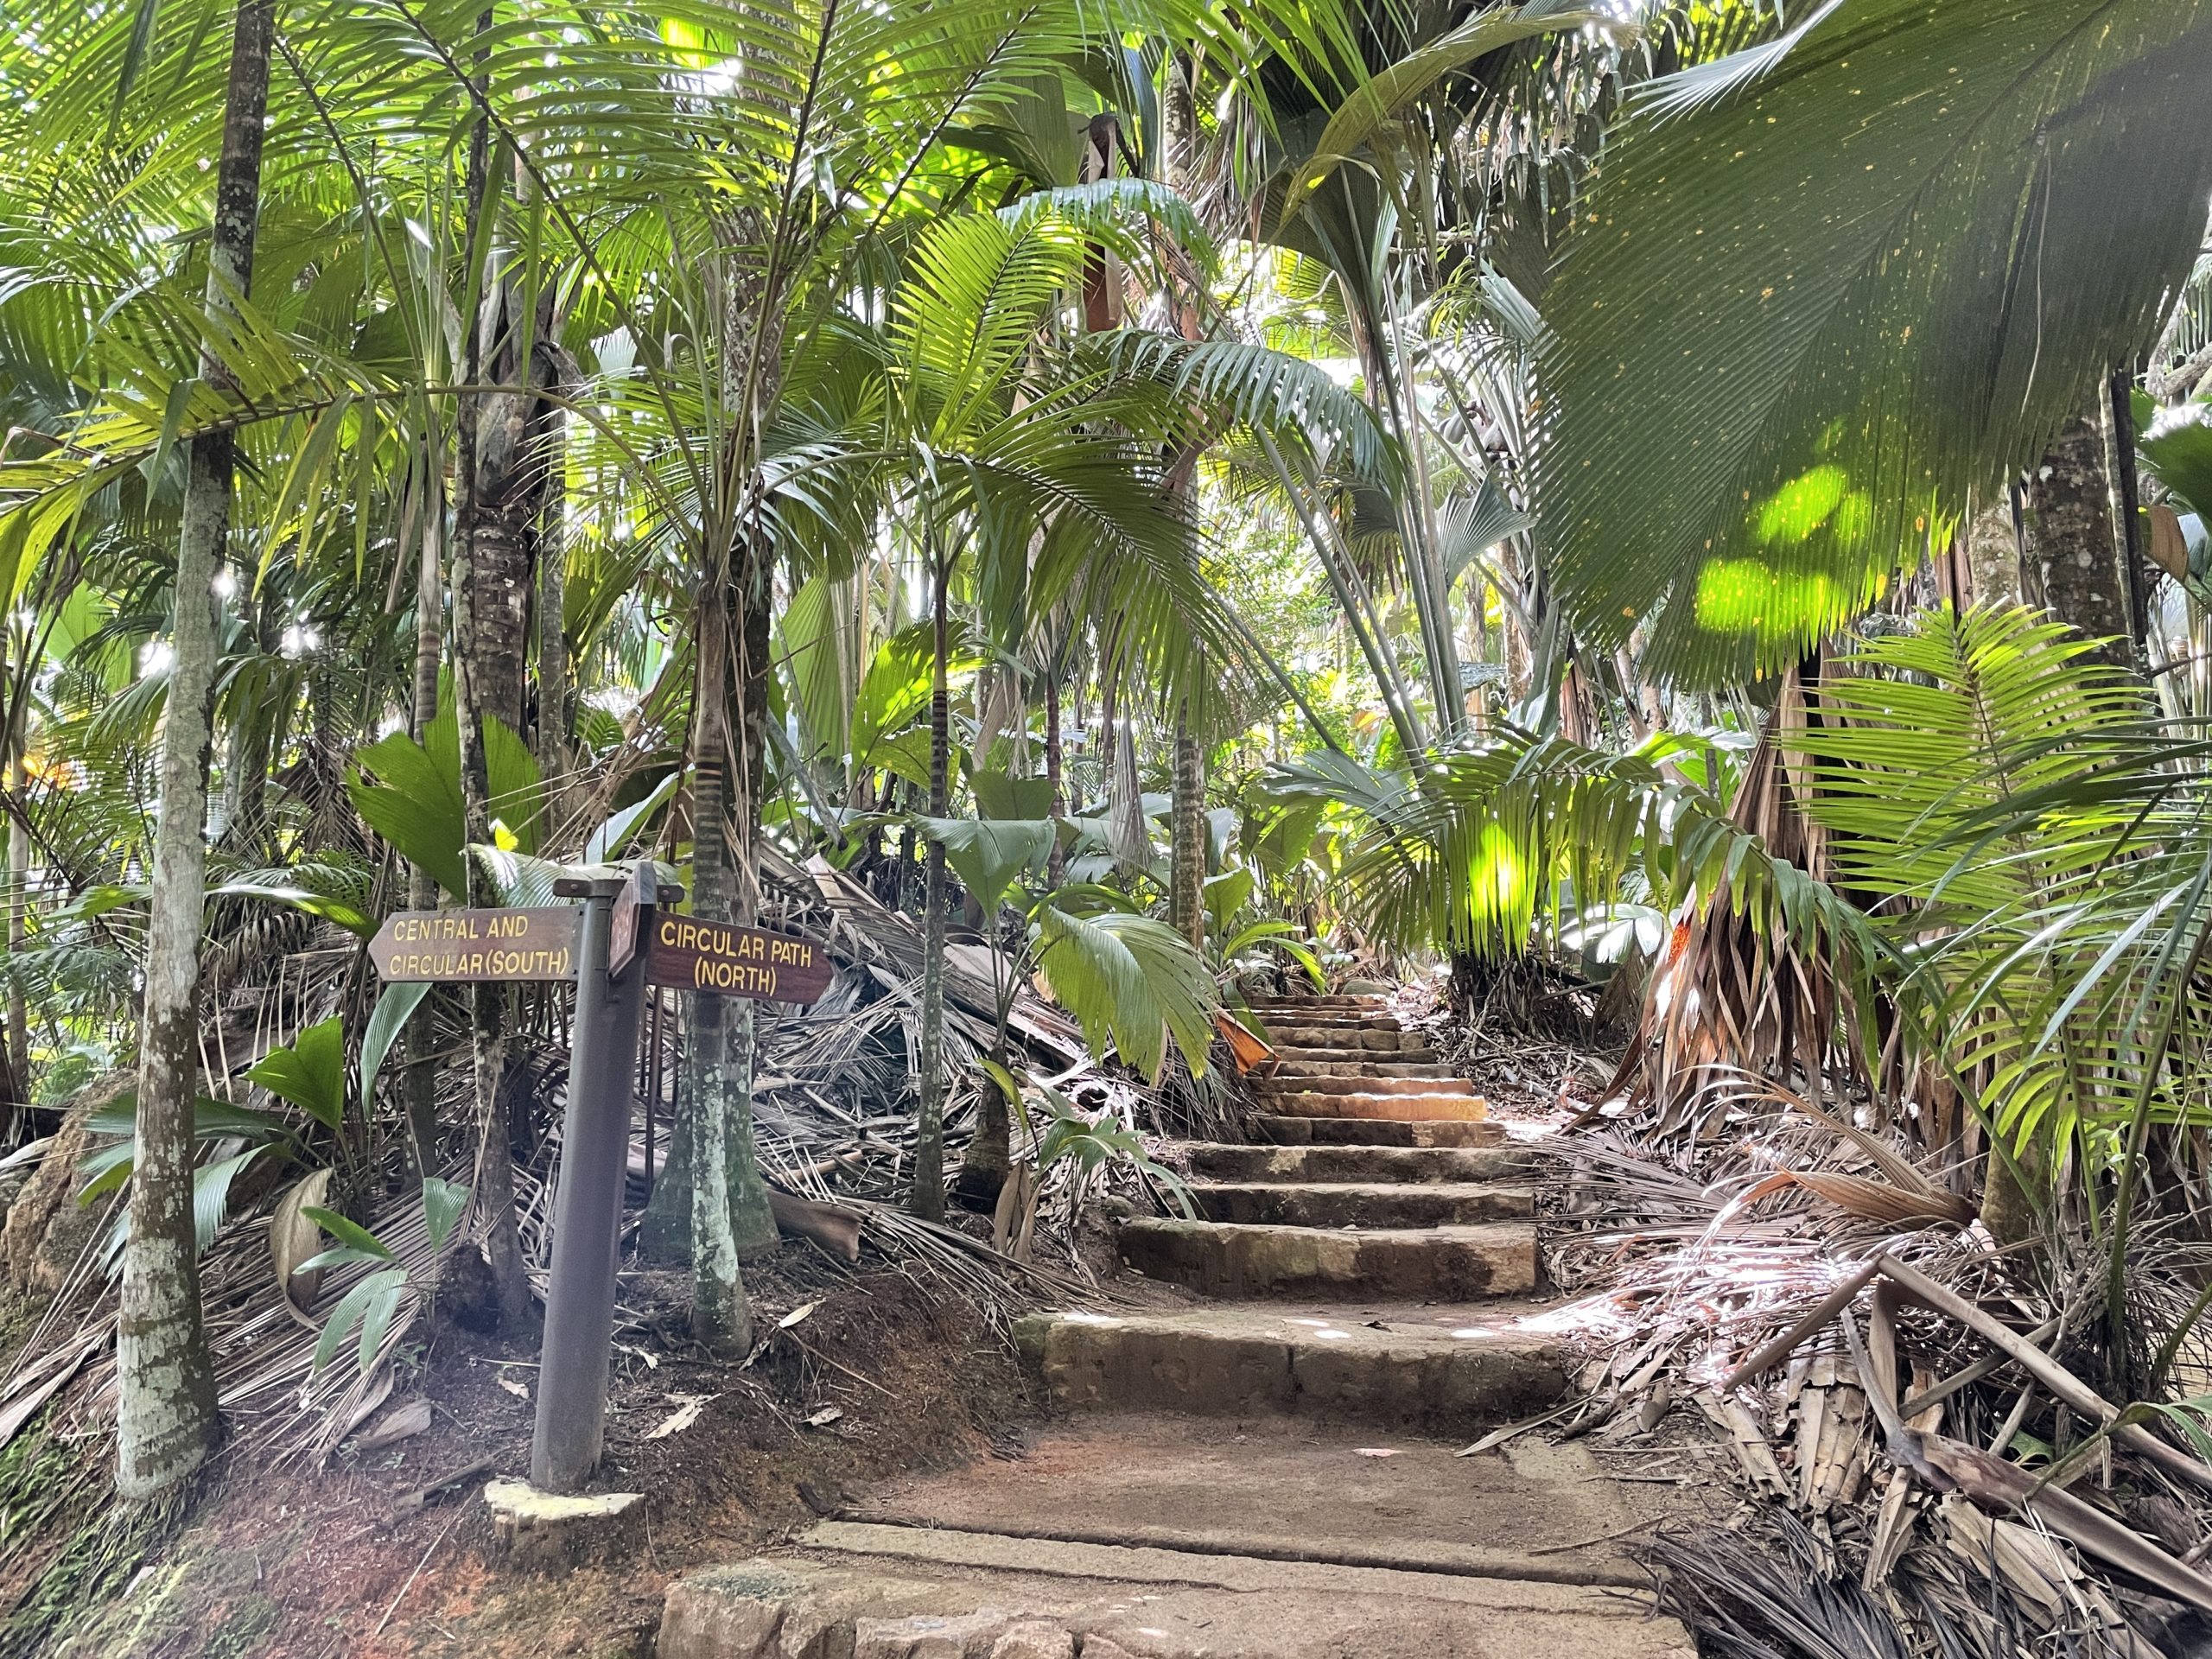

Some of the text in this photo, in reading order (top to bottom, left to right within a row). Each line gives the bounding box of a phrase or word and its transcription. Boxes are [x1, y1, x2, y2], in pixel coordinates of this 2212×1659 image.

[394, 915, 528, 941] CENTRAL AND
[660, 921, 765, 961] CIRCULAR
[771, 940, 811, 968] PATH
[695, 957, 777, 997] (NORTH)
